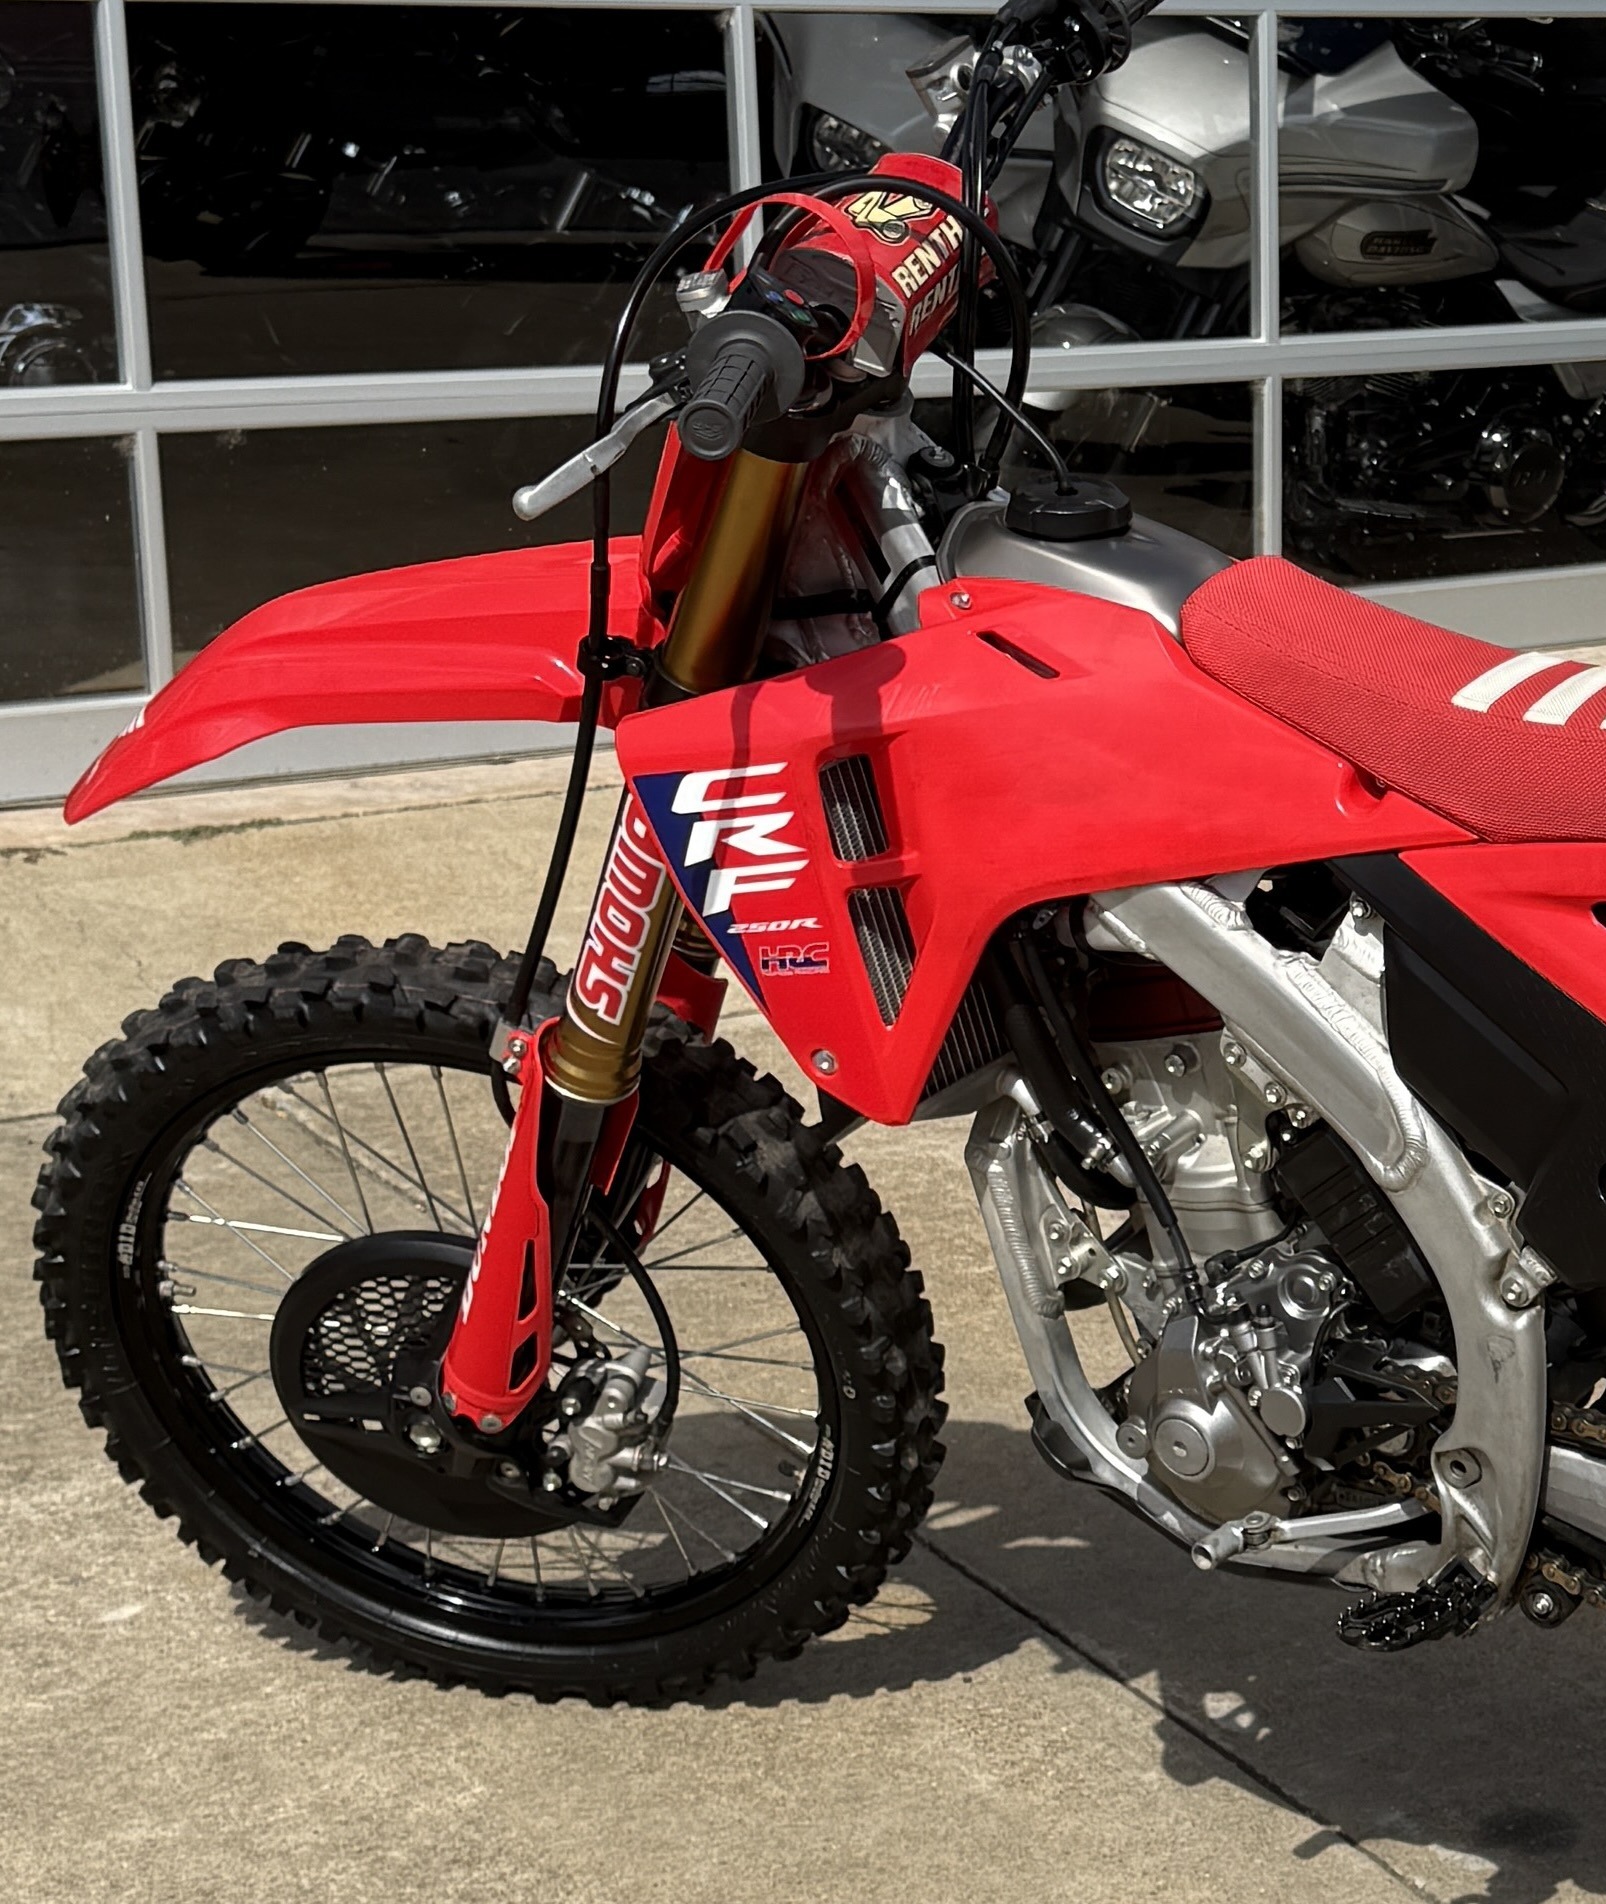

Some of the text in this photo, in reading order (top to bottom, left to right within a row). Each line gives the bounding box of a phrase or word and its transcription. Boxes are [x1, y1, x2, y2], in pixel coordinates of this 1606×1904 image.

[891, 214, 964, 298] RENTH
[671, 761, 810, 917] CRF
[727, 917, 823, 934] 250R
[759, 940, 830, 974] HRC
